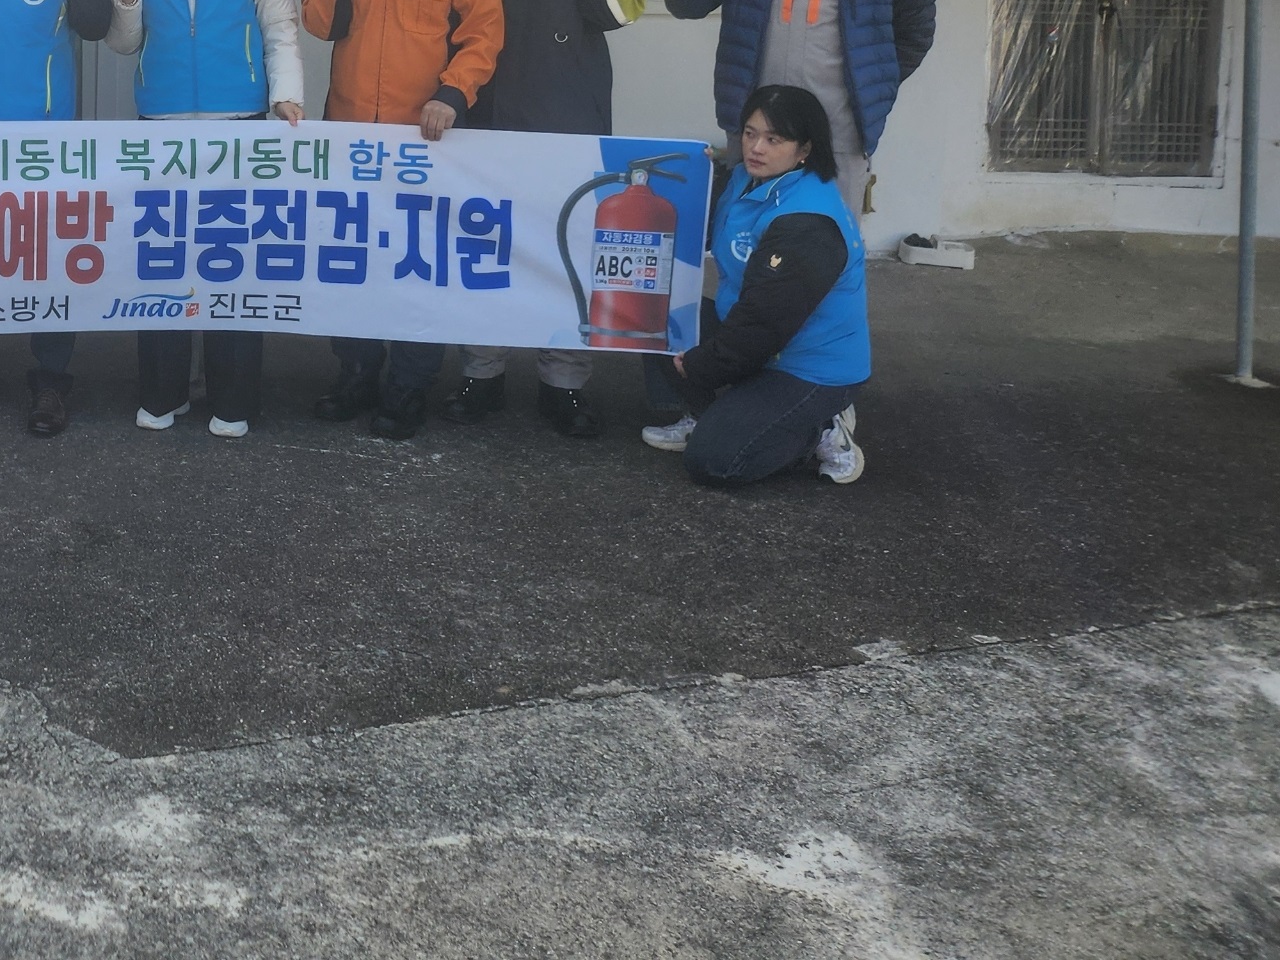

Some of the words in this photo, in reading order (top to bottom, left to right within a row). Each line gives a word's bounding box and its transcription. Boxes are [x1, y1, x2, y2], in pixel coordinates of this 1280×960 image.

[116, 139, 331, 182] 복지기동대
[350, 140, 434, 185] 합동
[595, 255, 632, 278] ABC
[102, 297, 184, 319] Jindo
[208, 292, 303, 323] 진도군
